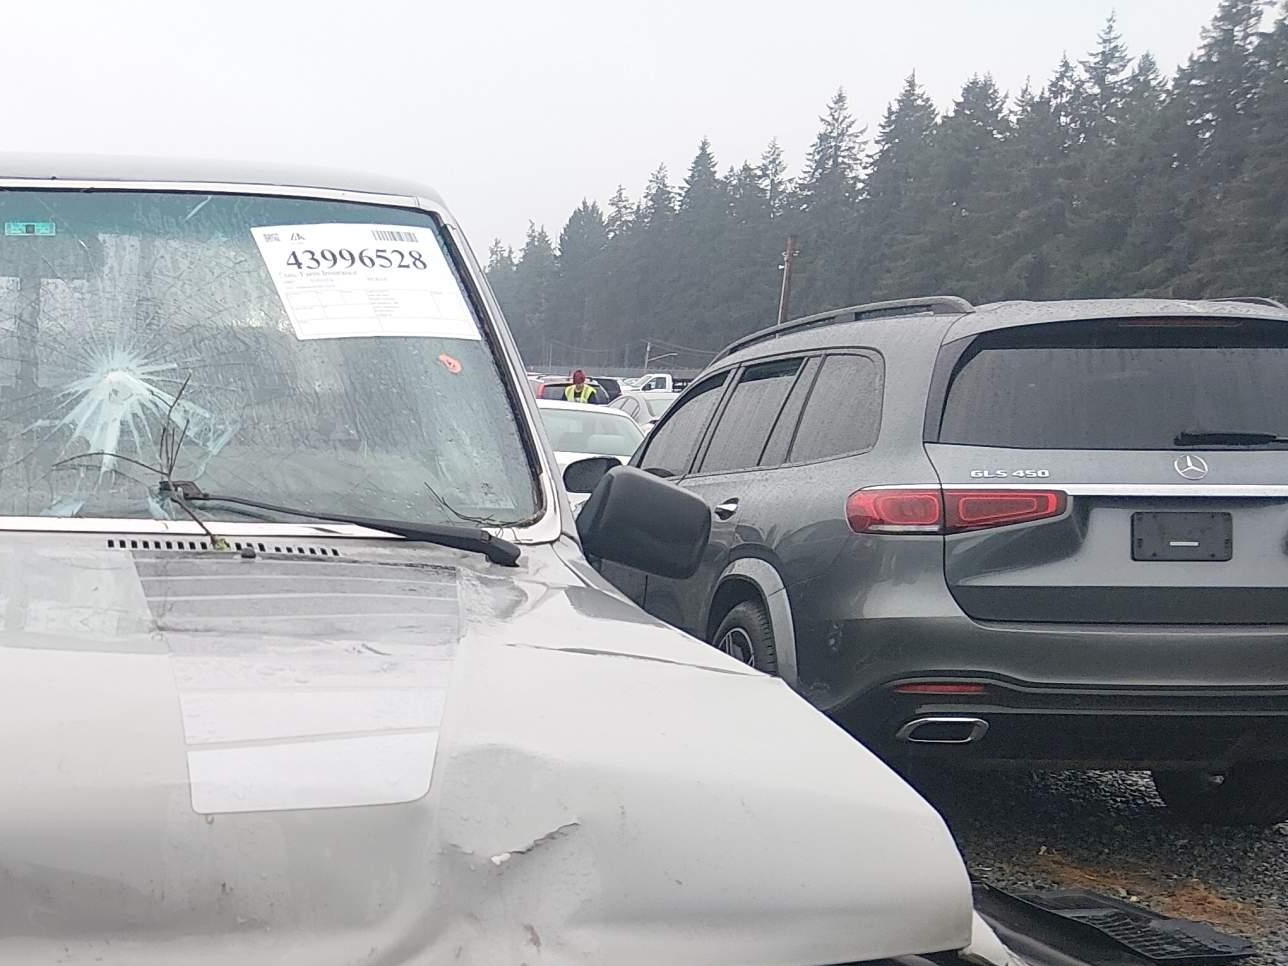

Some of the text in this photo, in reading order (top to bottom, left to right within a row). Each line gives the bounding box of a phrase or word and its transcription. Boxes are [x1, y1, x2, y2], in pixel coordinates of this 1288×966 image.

[286, 247, 428, 270] 43996528
[970, 469, 1050, 479] GLS 450
